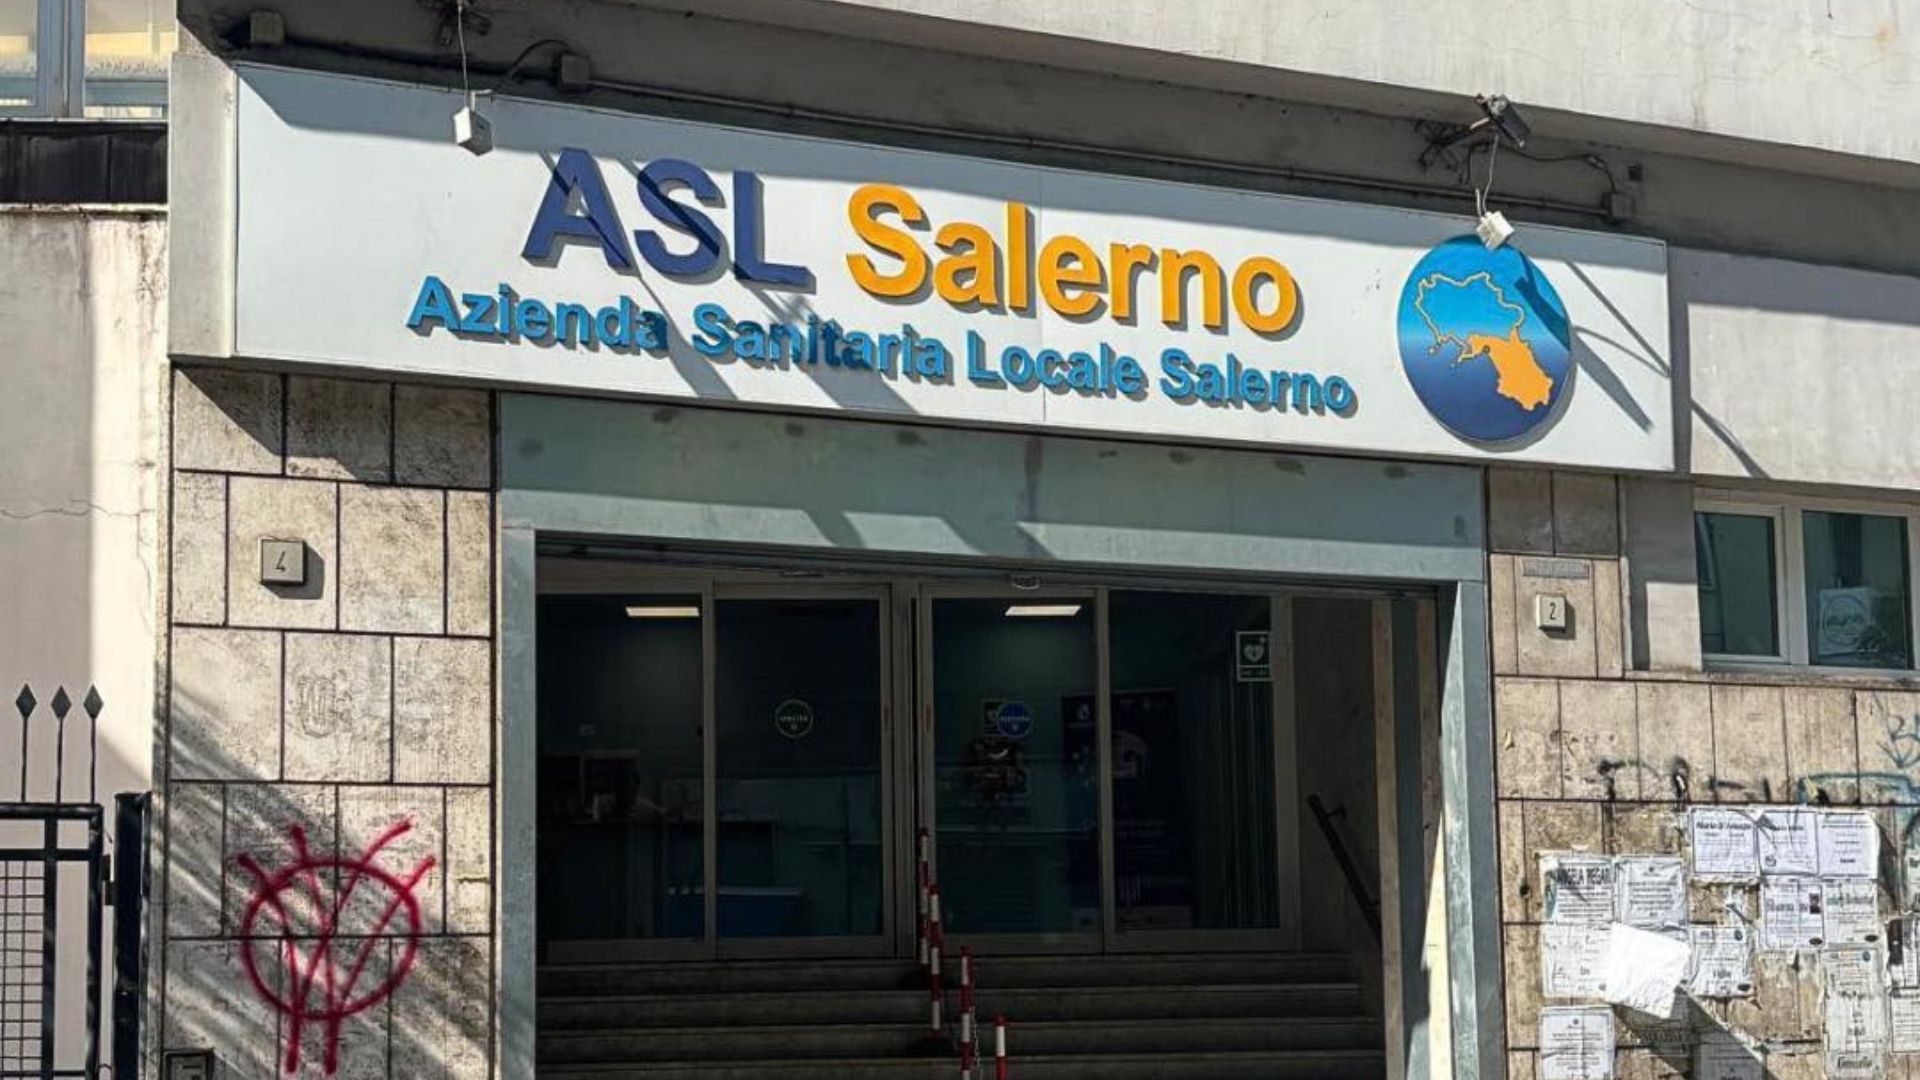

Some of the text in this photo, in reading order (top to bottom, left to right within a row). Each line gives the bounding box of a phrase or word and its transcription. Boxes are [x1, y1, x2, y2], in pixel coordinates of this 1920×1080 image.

[521, 147, 1299, 334] ASL Salerno
[406, 275, 1357, 413] Azienda Sanitaria Locale Salerno
[274, 551, 286, 571] 4
[1549, 602, 1557, 620] 2
